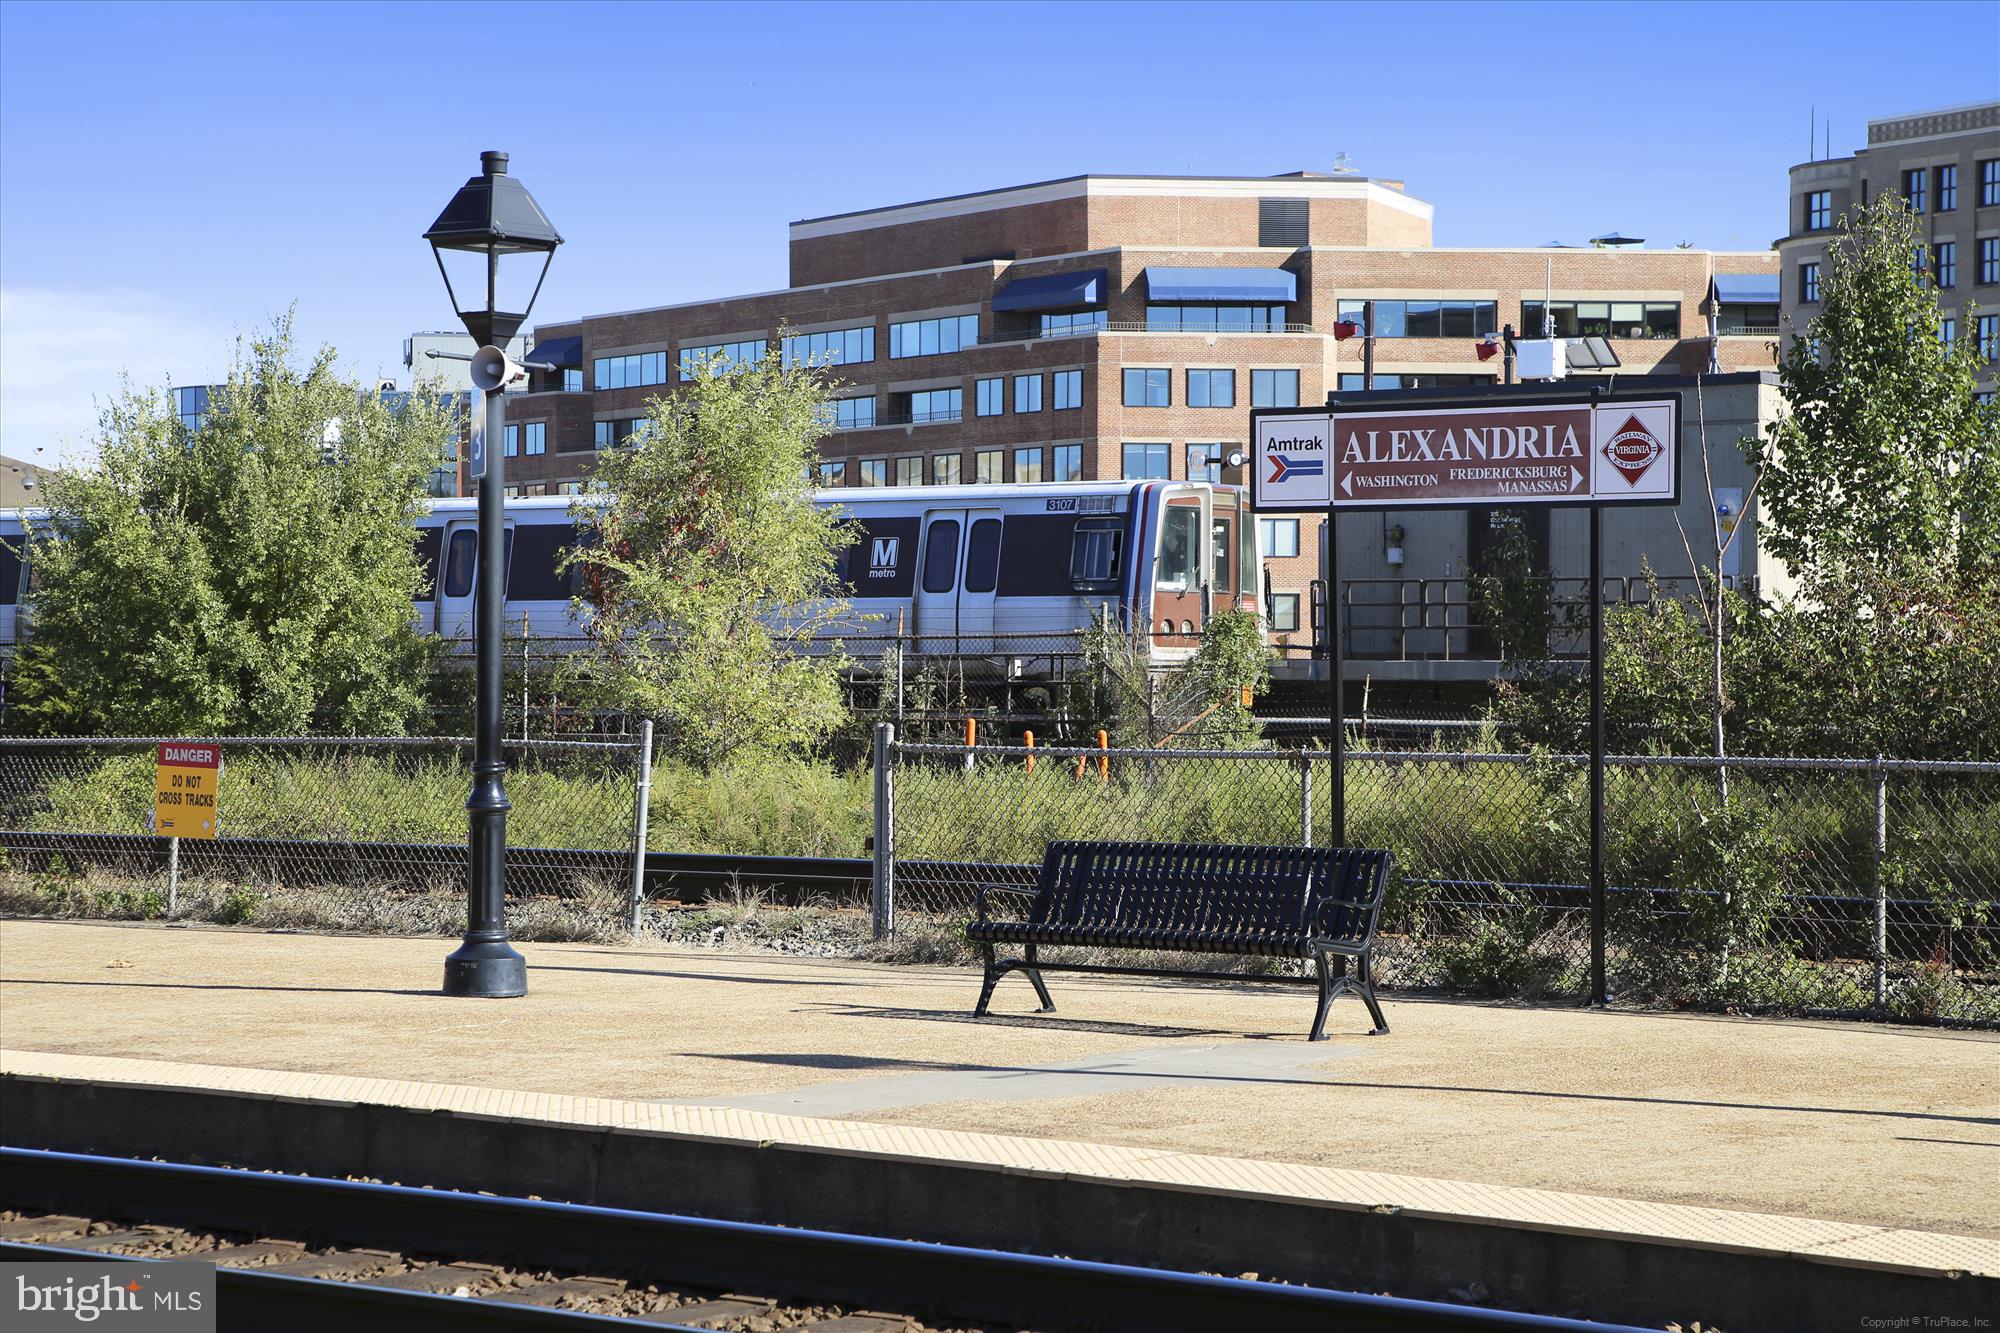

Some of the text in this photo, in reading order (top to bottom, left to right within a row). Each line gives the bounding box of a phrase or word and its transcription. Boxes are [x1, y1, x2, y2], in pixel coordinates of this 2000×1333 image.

[1267, 436, 1323, 451] Amtrak
[1341, 424, 1583, 464] ALEXANDRIA
[1614, 432, 1652, 443] RAILWAY
[1615, 445, 1650, 454] VIRGINIA
[1613, 457, 1652, 468] EXPRESS
[1450, 465, 1567, 481] FREDERICKSBURG
[1356, 474, 1438, 488] WASHINGTON
[1498, 480, 1568, 494] MANASSAS
[1048, 499, 1073, 510] 3107
[872, 539, 897, 566] M
[869, 568, 896, 578] metro
[165, 747, 212, 763] DANGER
[172, 774, 202, 789] DO NOT
[159, 791, 214, 807] CROSS TRACKS
